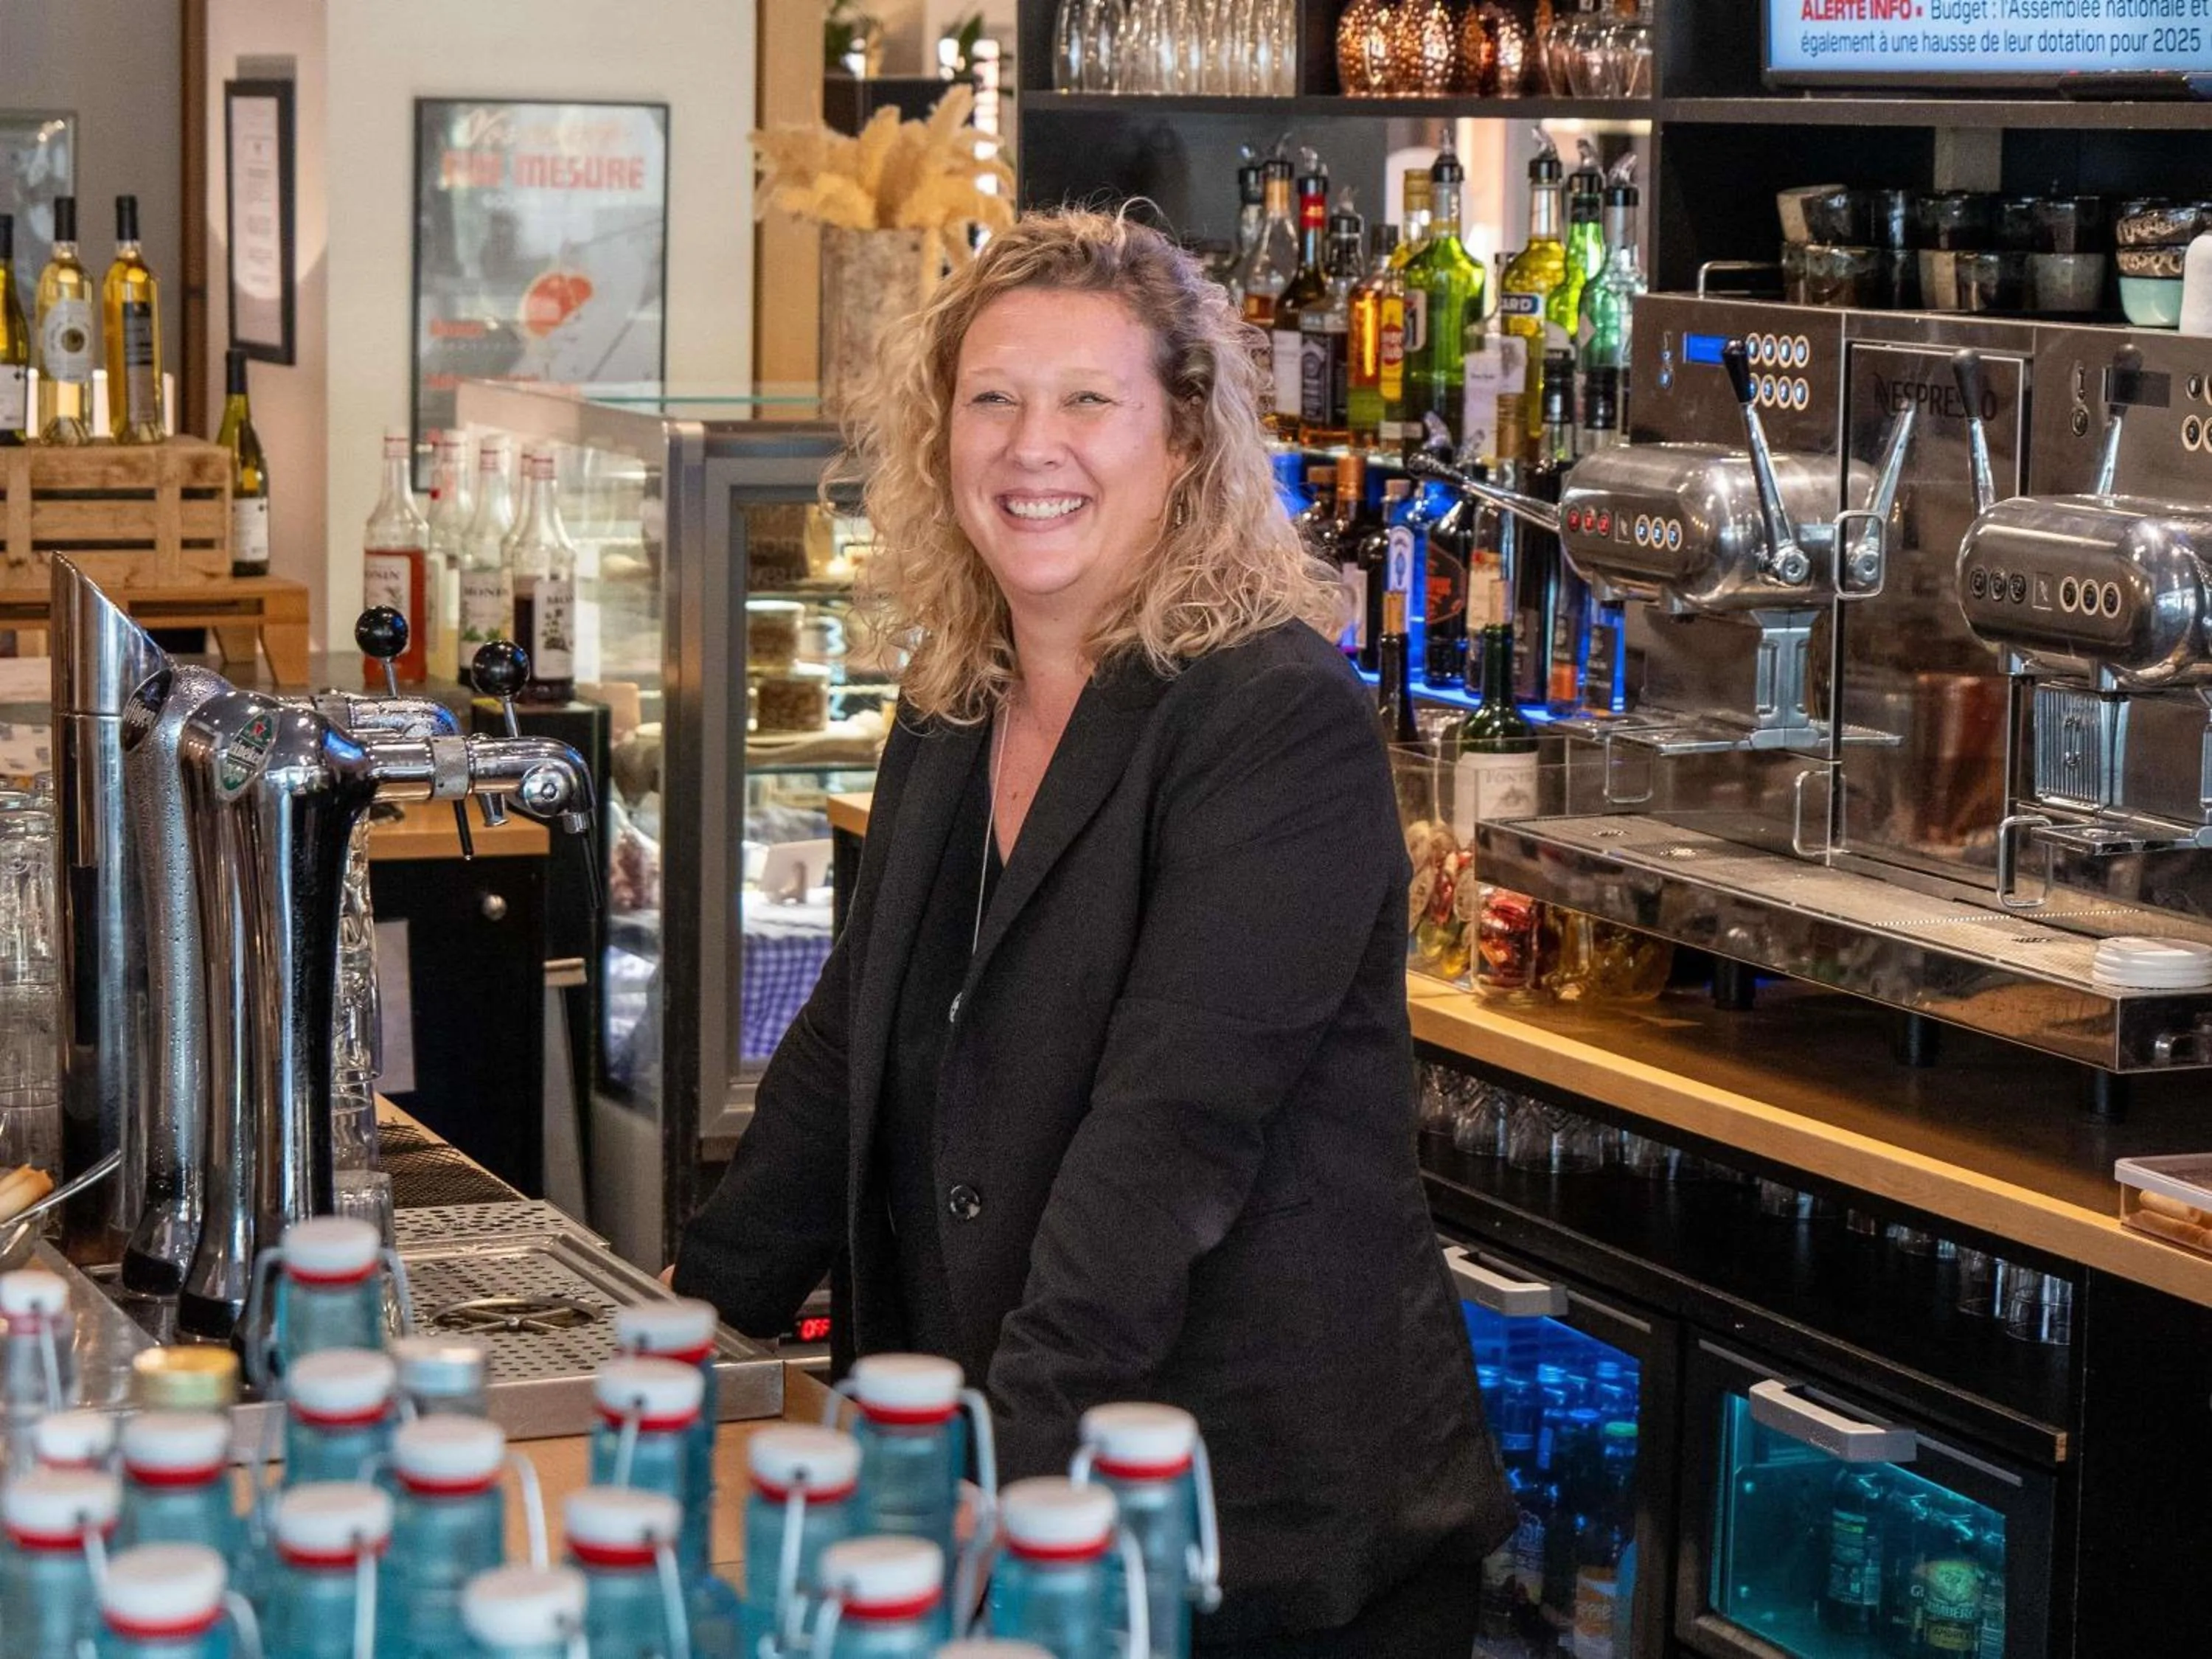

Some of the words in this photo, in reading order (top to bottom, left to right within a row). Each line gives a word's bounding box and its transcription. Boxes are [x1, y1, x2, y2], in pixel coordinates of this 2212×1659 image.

[1801, 0, 1867, 21] ALERTE
[1870, 0, 1912, 21] INFO
[1931, 0, 1988, 24] Budget
[2106, 0, 2185, 18] nationale
[2191, 0, 2209, 18] et
[1801, 31, 1876, 57] également
[1880, 32, 1888, 52] à
[1892, 36, 1917, 52] une
[1922, 31, 1976, 53] hausse
[1980, 31, 2000, 52] de
[2004, 30, 2034, 52] leur
[2037, 29, 2105, 53] dotation
[2110, 35, 2149, 56] pour
[2153, 27, 2201, 53] 2025
[1871, 372, 1997, 421] NESPREO
